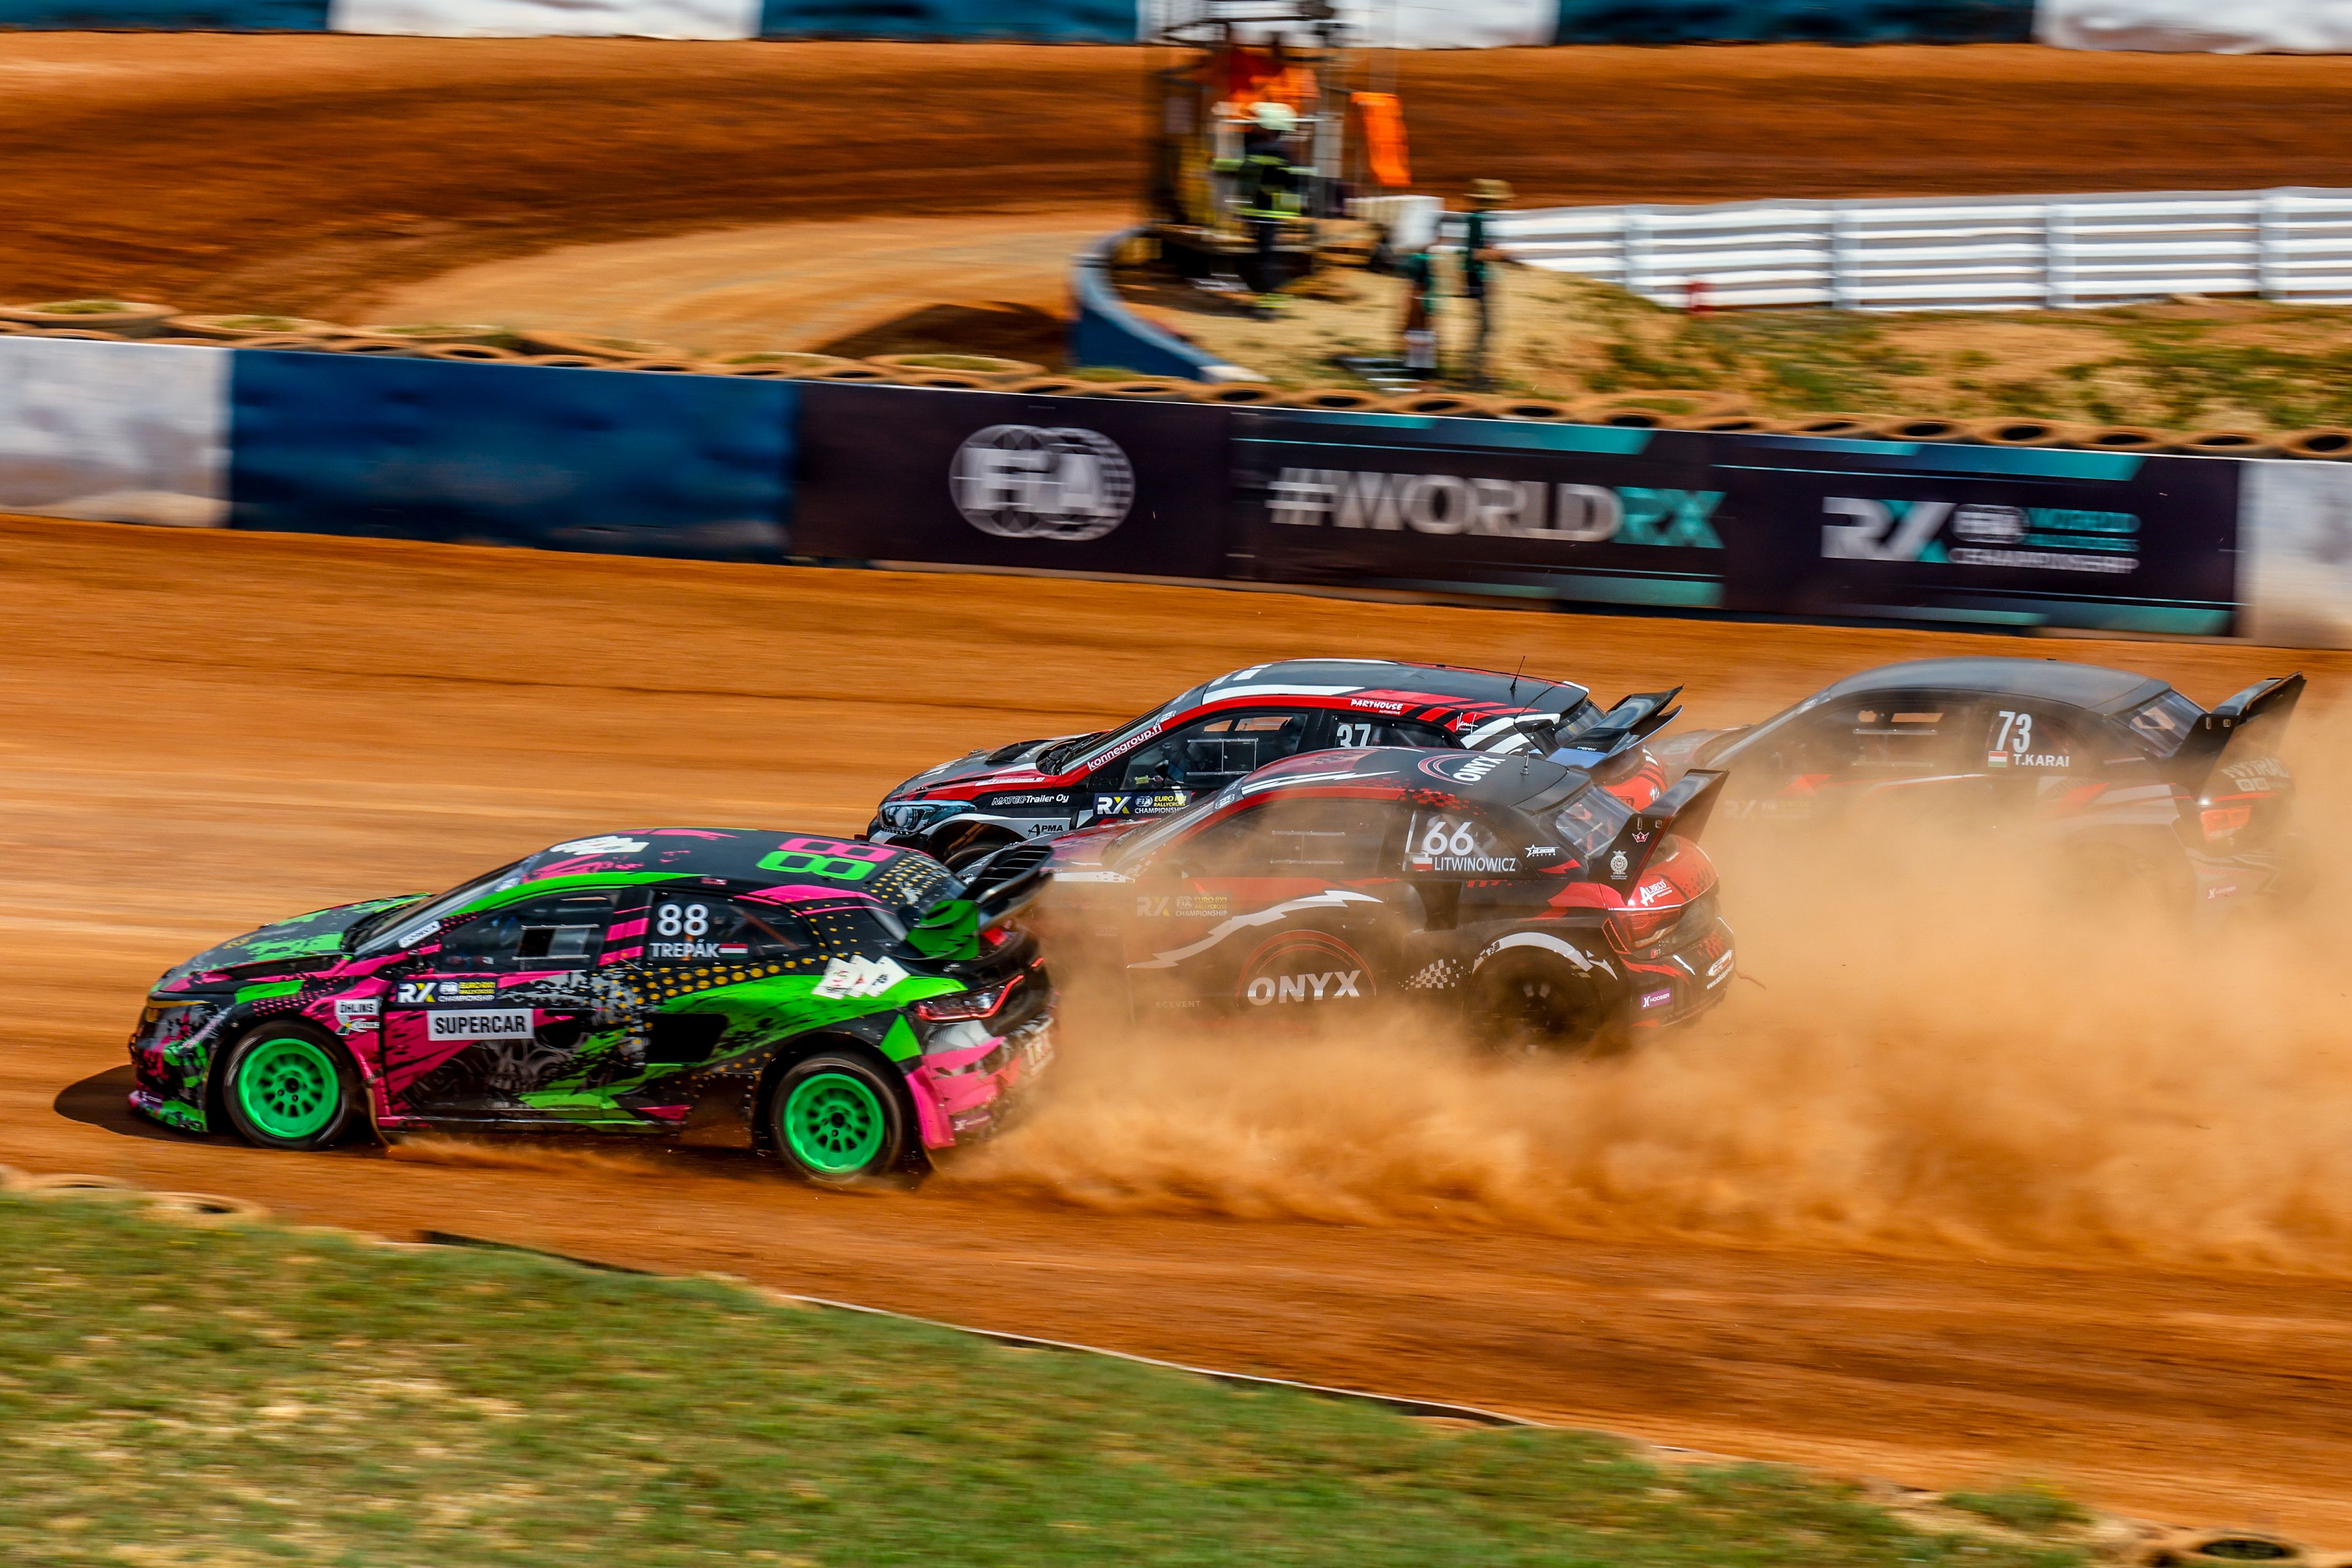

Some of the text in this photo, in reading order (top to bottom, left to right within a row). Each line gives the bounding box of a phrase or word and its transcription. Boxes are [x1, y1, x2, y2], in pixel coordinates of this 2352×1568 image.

[1265, 467, 1727, 549] #WORLDRX
[1821, 496, 1957, 564] RX
[1351, 699, 1404, 710] PARTHOUSE
[1336, 723, 1371, 747] 37
[1996, 710, 2032, 753] 73
[1087, 723, 1163, 771] konnegroup.fi
[1453, 755, 1506, 782] ONYX
[2013, 754, 2070, 767] T.KARAI
[1056, 794, 1069, 804] Oy
[1097, 797, 1132, 815] RX
[1422, 821, 1474, 856] 66
[1434, 857, 1516, 872] LITWINOWICZ
[1639, 880, 1667, 907] ALBECO
[1137, 896, 1170, 916] RX
[657, 904, 709, 937] 88
[649, 939, 720, 958] TREPÁK
[399, 982, 437, 1003] RX
[1247, 970, 1362, 1006] ONYX
[435, 1016, 527, 1035] SUPERCAR
